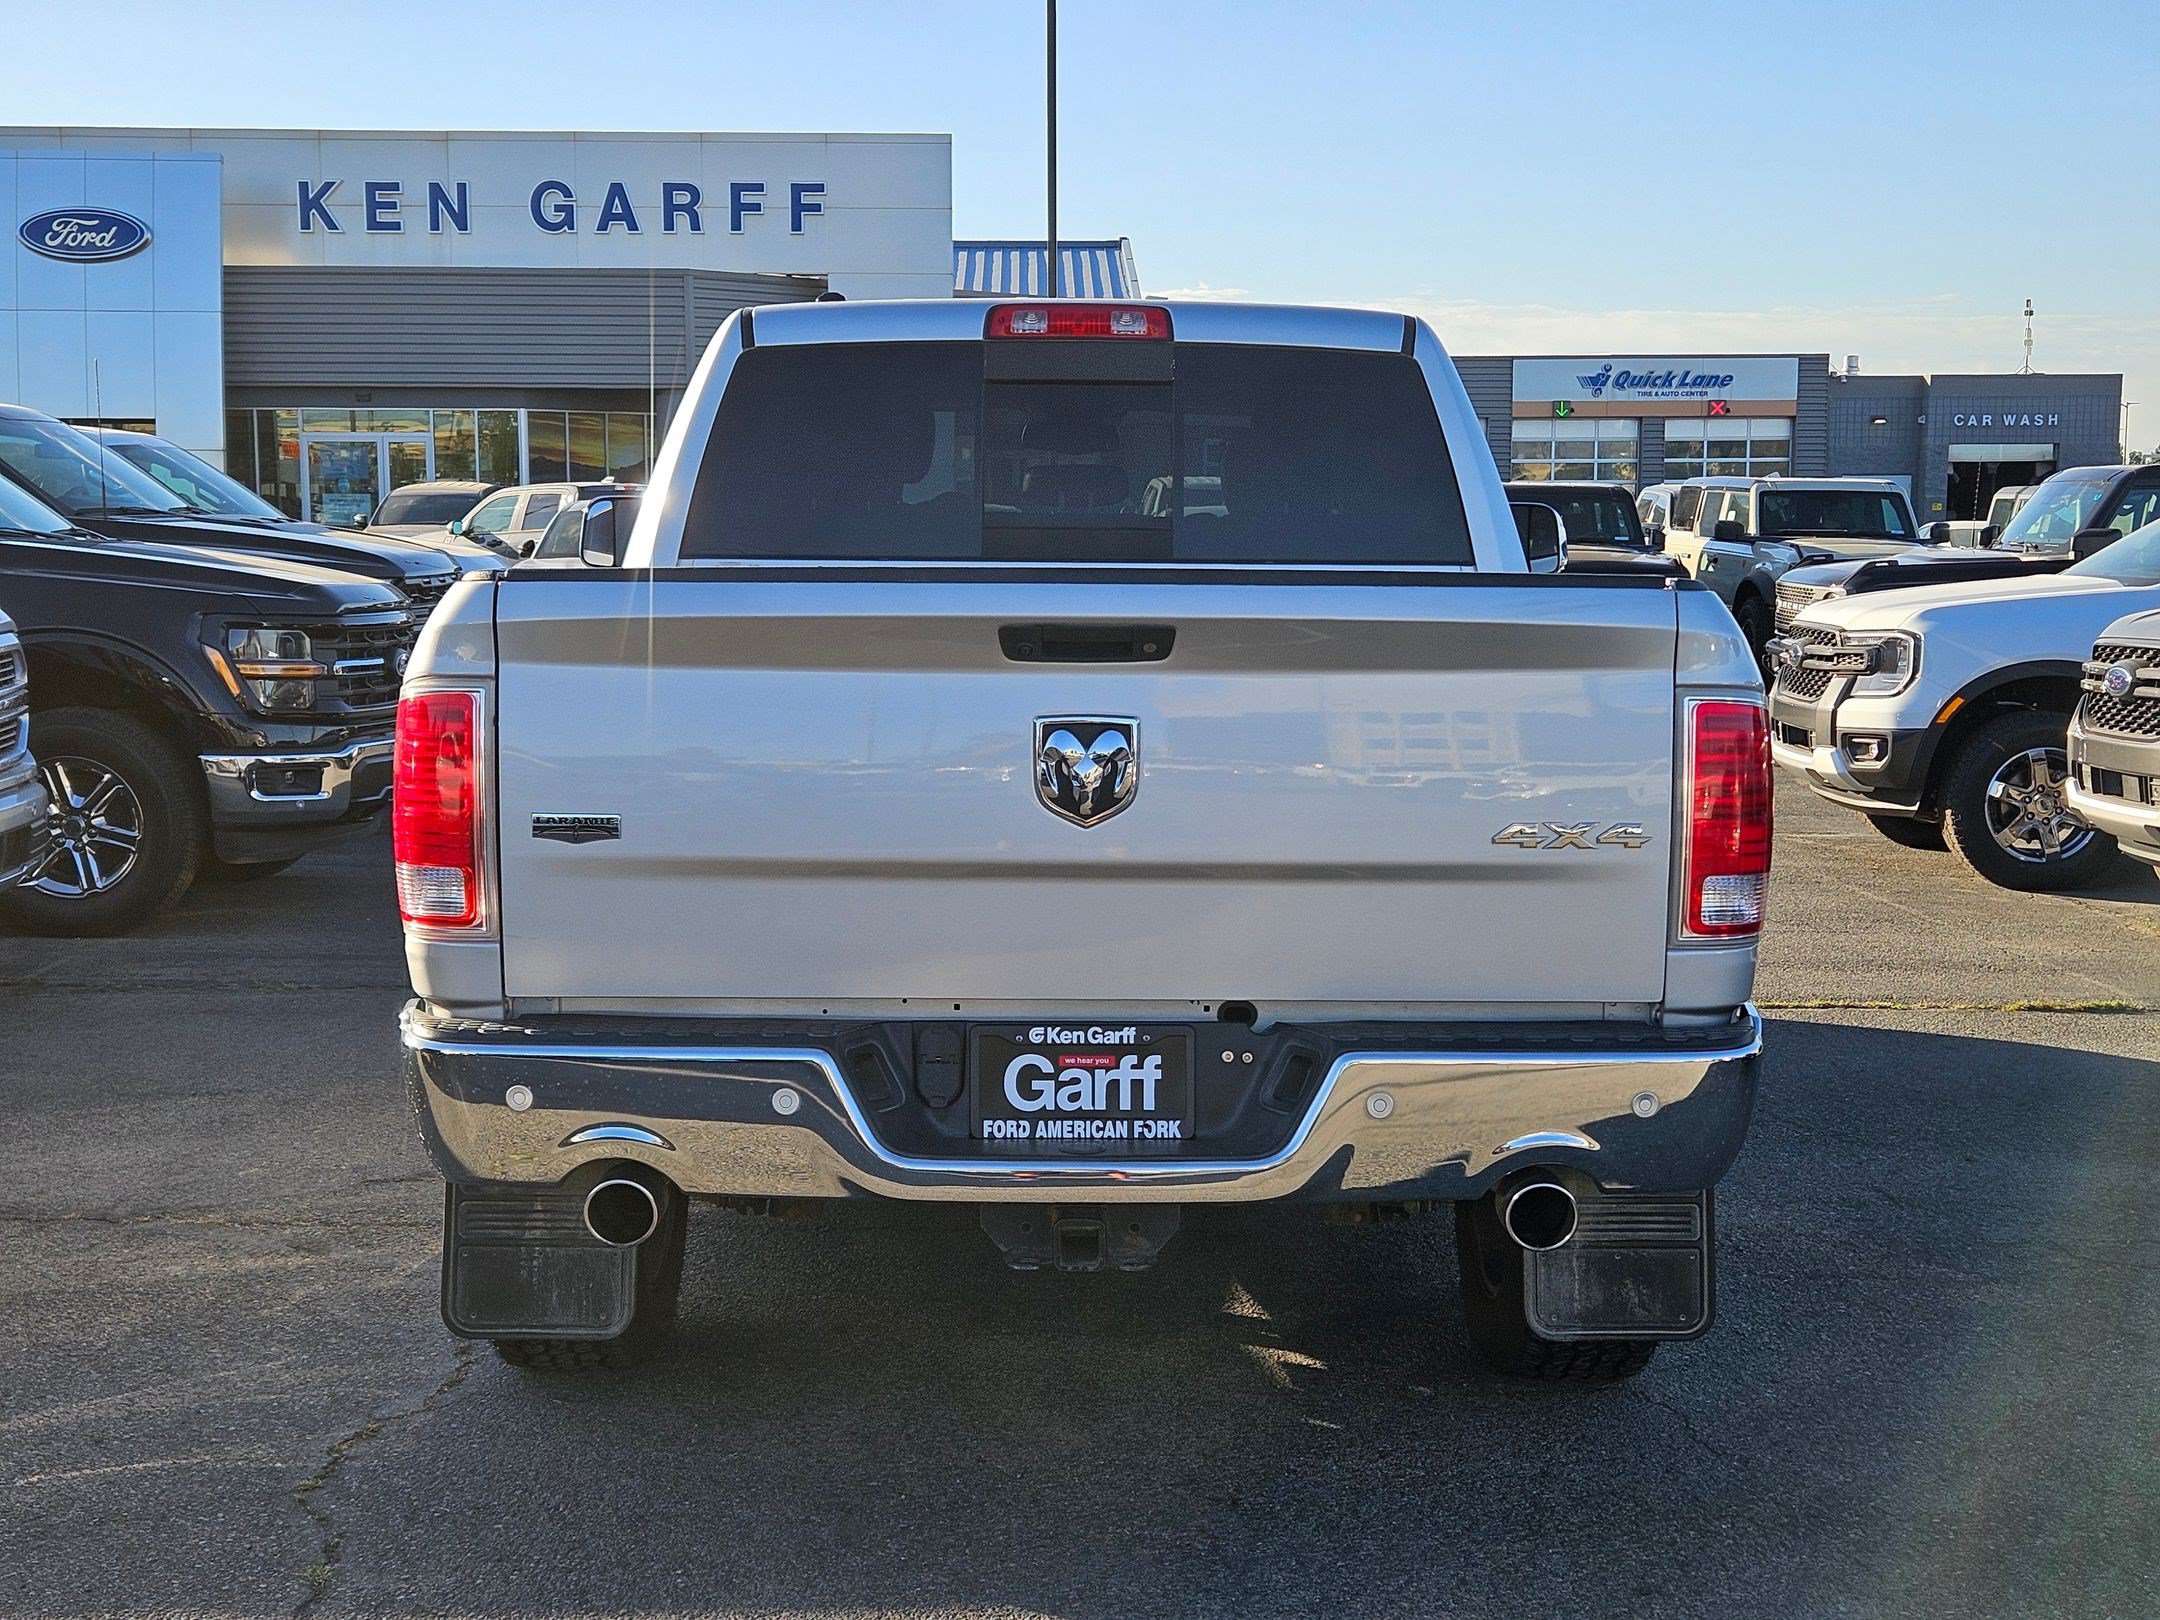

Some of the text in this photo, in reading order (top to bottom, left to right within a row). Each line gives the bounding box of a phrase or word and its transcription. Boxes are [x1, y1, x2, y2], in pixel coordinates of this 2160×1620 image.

[297, 179, 828, 235] KEN GARFF
[44, 217, 118, 247] Ford
[1612, 369, 1734, 391] Quick Lane
[1637, 390, 1709, 398] TIRE & AUTO CENTER
[1953, 414, 2059, 426] CAR WASH
[532, 816, 619, 826] LARAMIE
[1047, 1026, 1137, 1044] Ken Garff
[1077, 1056, 1094, 1064] hear
[1094, 1057, 1110, 1065] you
[1003, 1053, 1162, 1112] Garff
[983, 1119, 1182, 1139] FORD AMERICAN FORK
